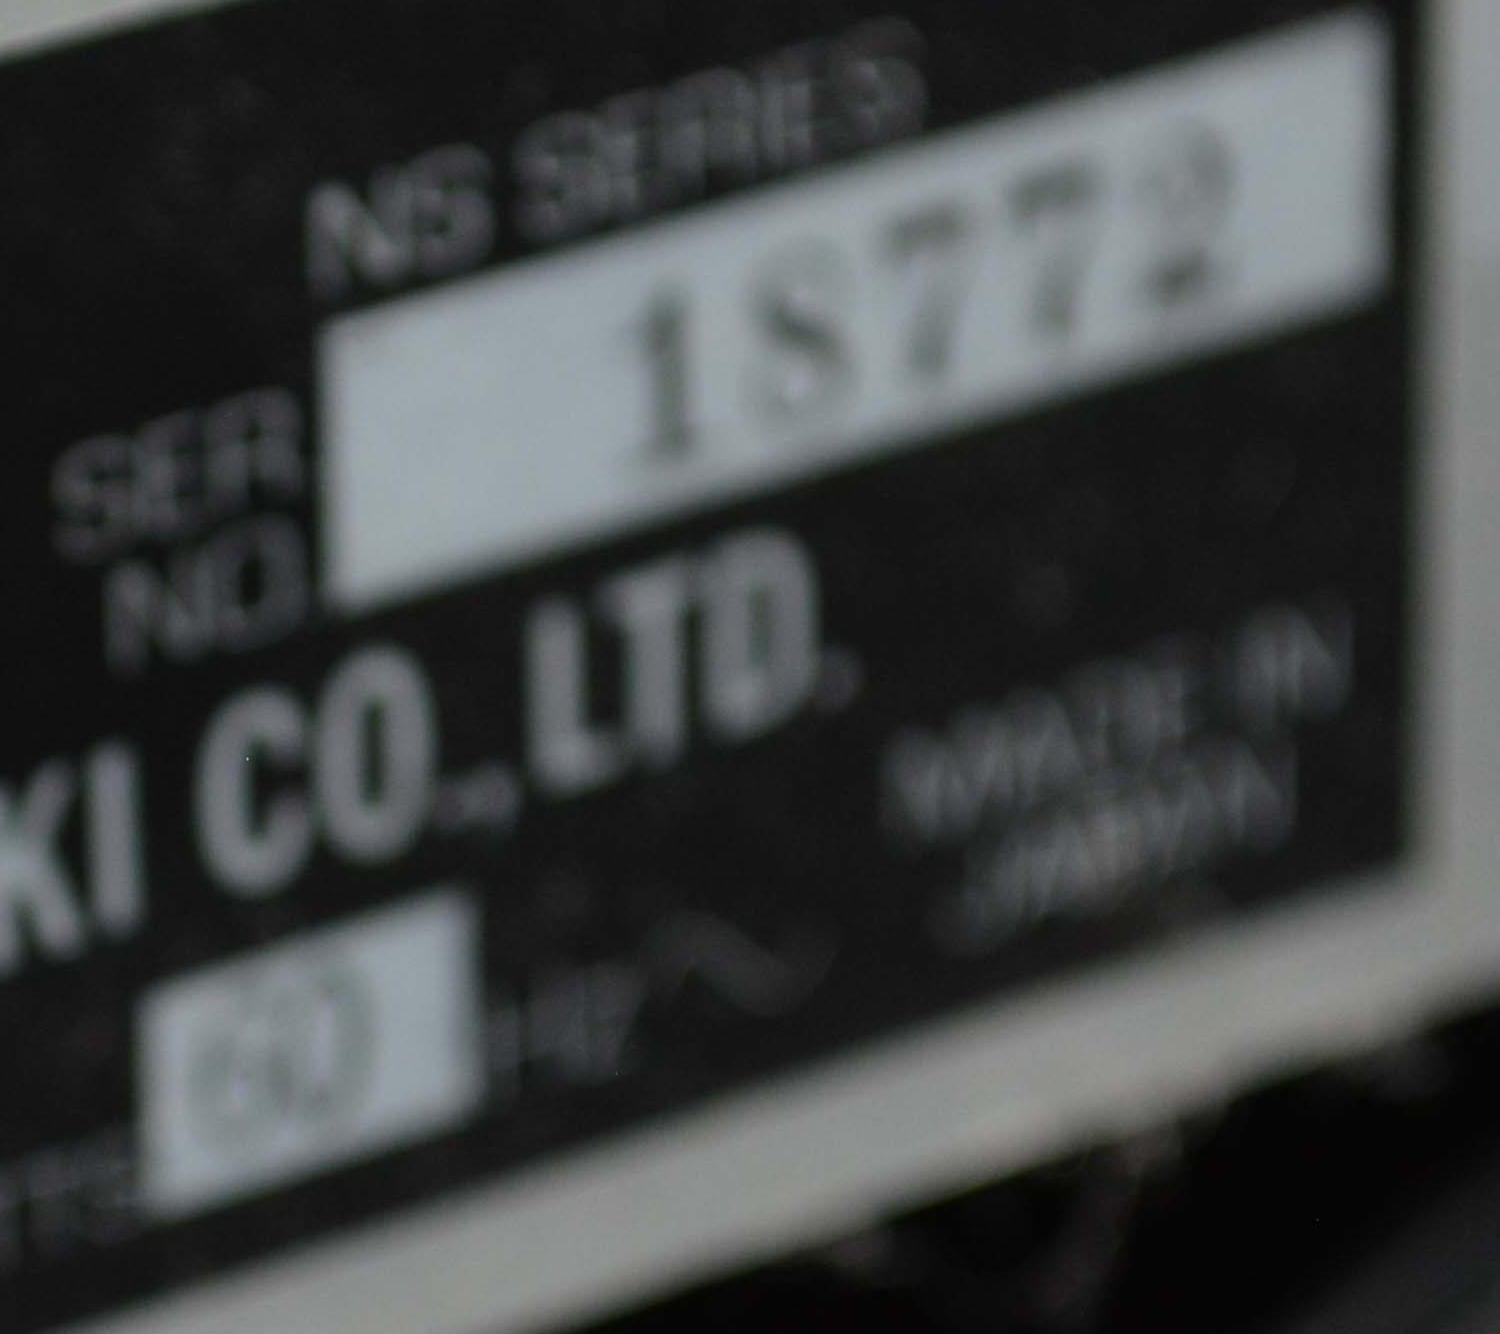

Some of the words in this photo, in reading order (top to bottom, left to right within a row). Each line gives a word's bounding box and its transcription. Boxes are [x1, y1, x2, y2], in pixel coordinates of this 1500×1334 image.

[305, 142, 494, 293] NS
[510, 12, 930, 244] SERIES
[622, 107, 1238, 467] 18772
[50, 385, 308, 565] SER
[877, 633, 1200, 847] MADE
[1234, 593, 1356, 730] IN
[182, 945, 384, 1161] 60
